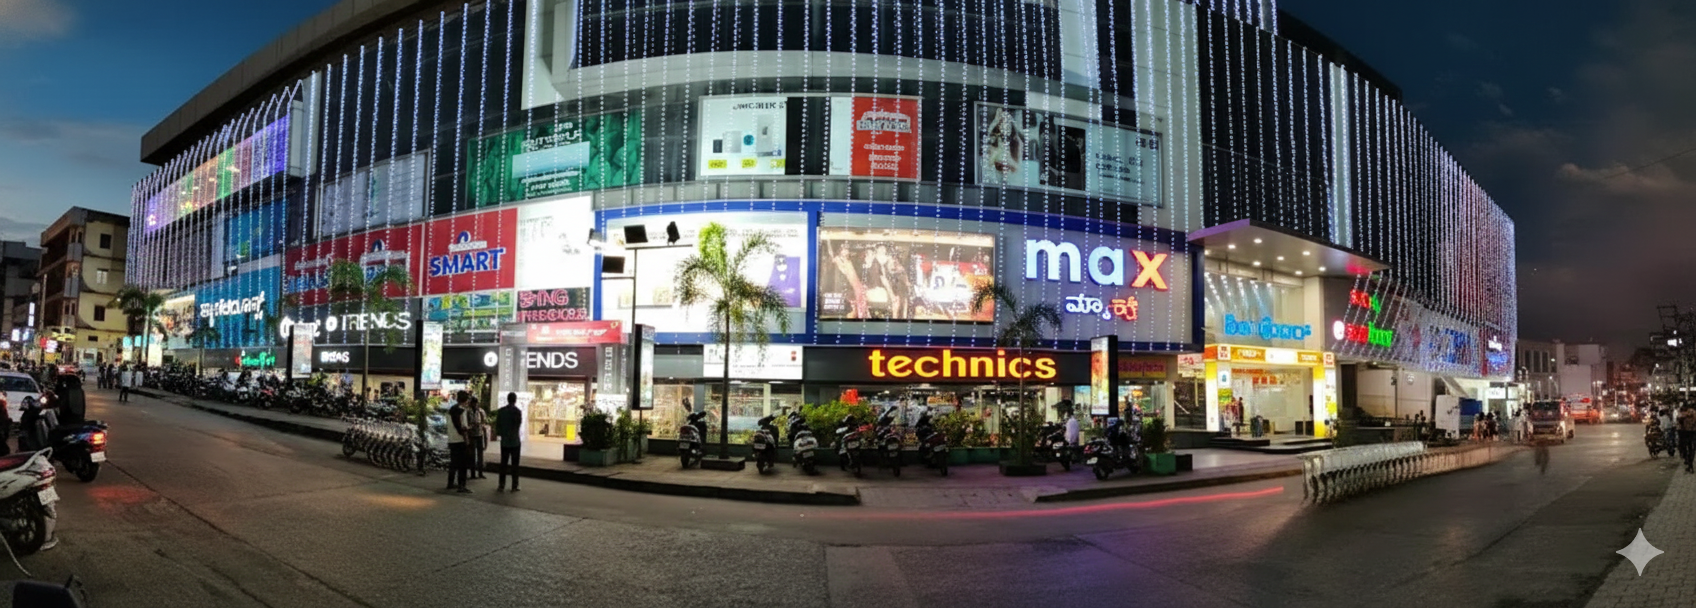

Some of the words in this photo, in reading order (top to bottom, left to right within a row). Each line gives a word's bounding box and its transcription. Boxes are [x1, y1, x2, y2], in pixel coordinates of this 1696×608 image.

[430, 247, 506, 277] SMART
[1025, 238, 1168, 291] max
[526, 351, 579, 369] ENDS
[868, 349, 1057, 379] technics
